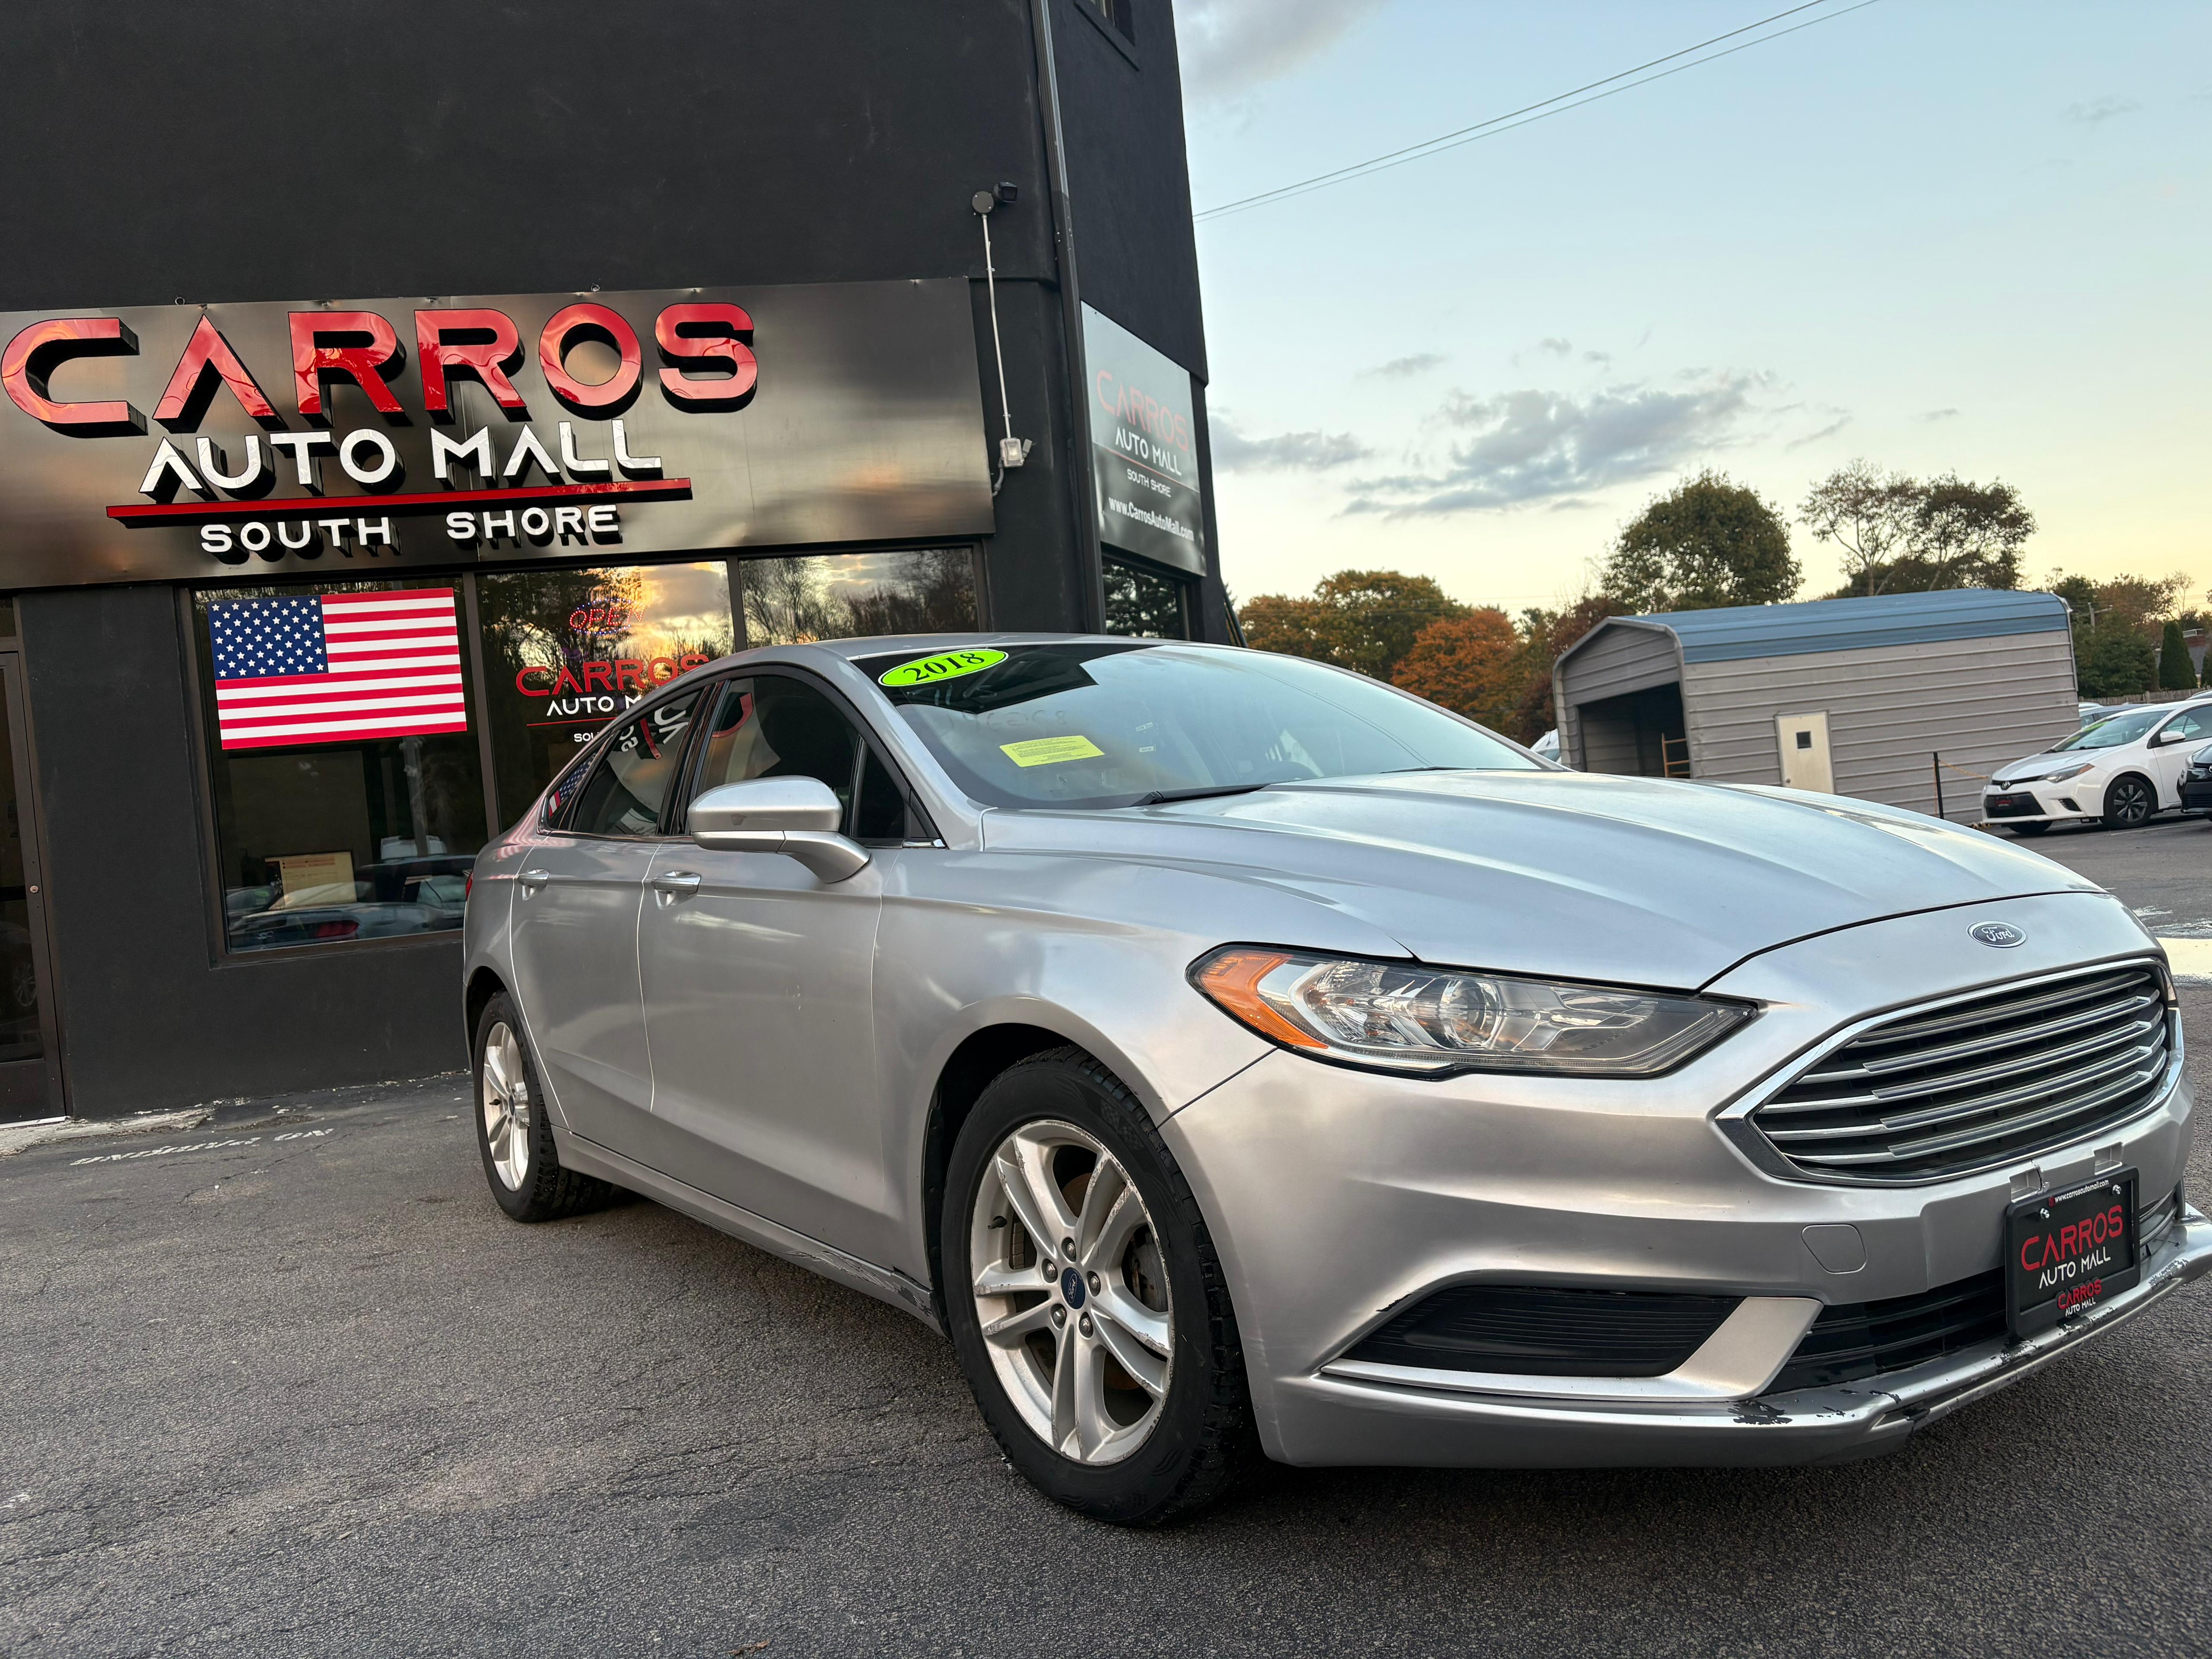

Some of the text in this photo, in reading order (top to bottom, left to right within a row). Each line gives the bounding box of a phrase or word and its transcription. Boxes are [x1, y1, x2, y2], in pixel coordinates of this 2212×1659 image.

[1, 302, 758, 424] CARROS
[1096, 370, 1189, 452] CARROS
[139, 419, 661, 494] AUTO MALL
[1116, 427, 1182, 476] AUTO MALL
[1127, 468, 1171, 497] SOUTH SHORE
[201, 505, 619, 553] SOUTH SHORE
[1109, 497, 1194, 541] www.CarrosAutoMall.com
[569, 606, 645, 629] OPEN
[903, 653, 985, 681] 2018
[547, 696, 614, 716] AUTO
[1981, 926, 2015, 942] Ford
[2055, 1179, 2109, 1203] www.carrosautomall.com
[2021, 1205, 2123, 1271] CARROS
[2039, 1246, 2111, 1289] AUTO MALL
[2057, 1279, 2102, 1309] CARROS
[2065, 1297, 2096, 1317] AUTO MALL
